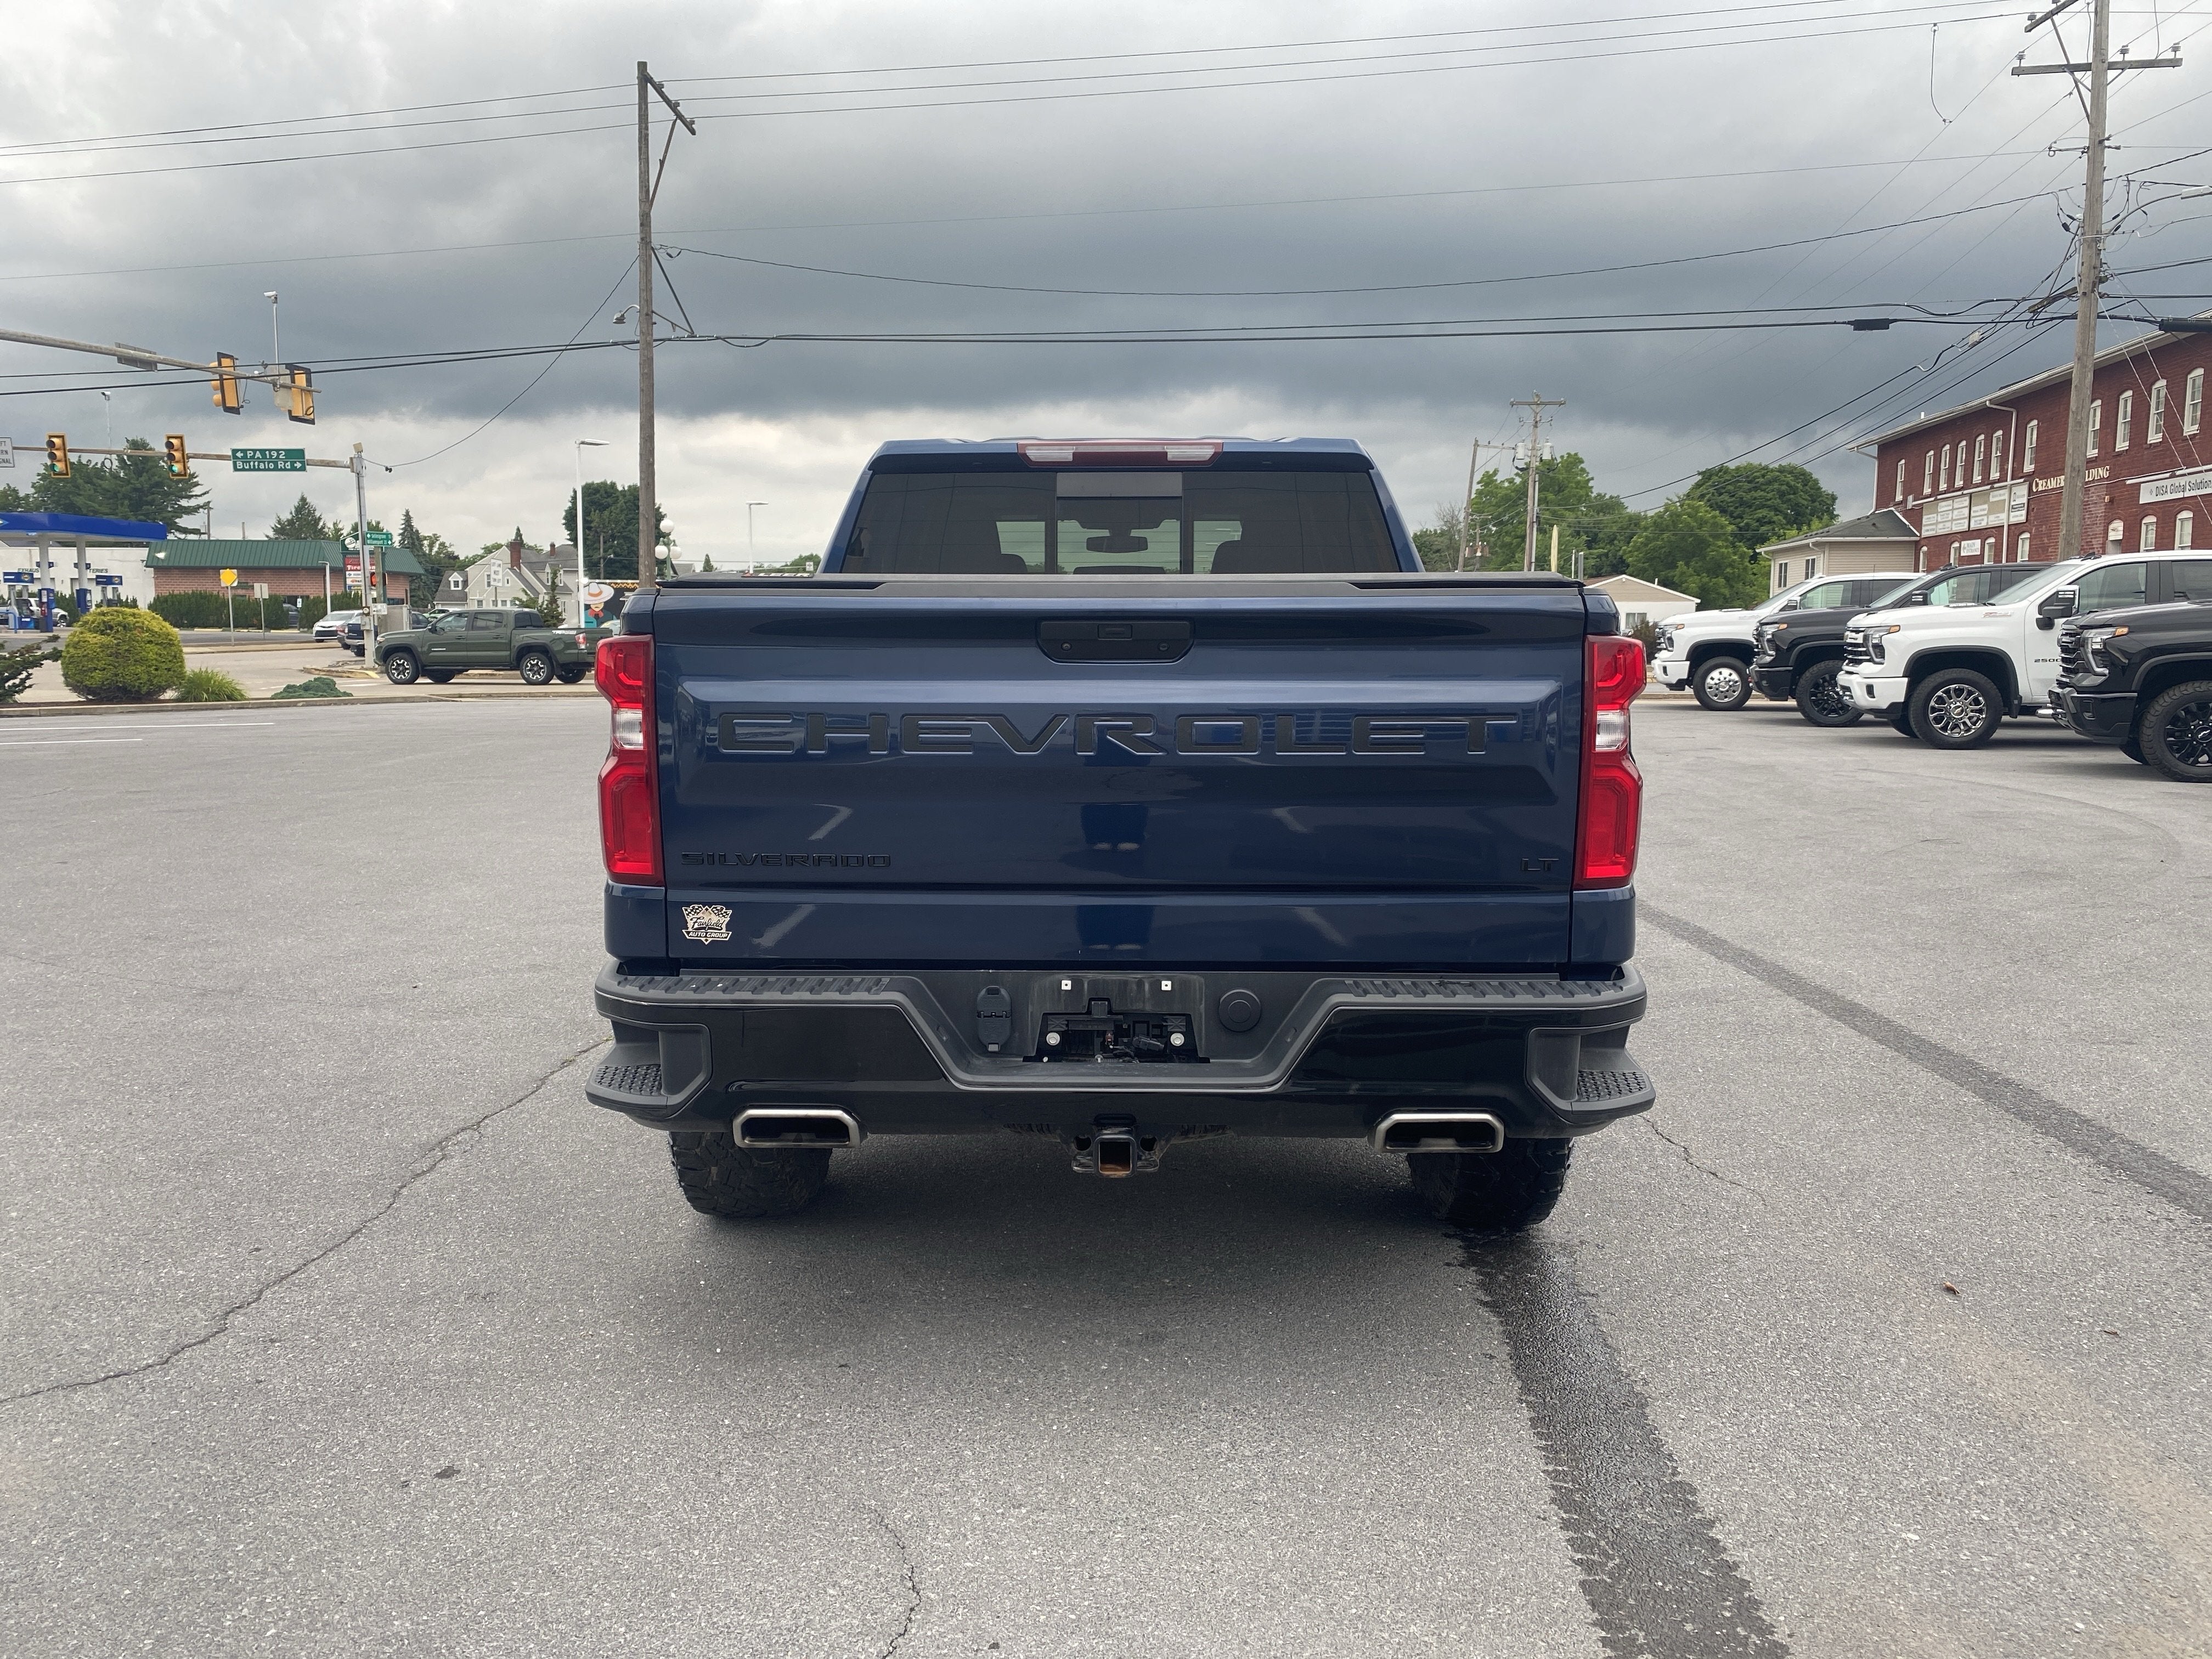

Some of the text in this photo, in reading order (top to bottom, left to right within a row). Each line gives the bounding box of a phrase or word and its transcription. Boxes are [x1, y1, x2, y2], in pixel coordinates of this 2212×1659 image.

[246, 450, 286, 459] PA 192
[236, 461, 291, 469] Buffalo Rd
[2085, 465, 2110, 482] LDING
[2155, 485, 2168, 496] DISA
[2170, 481, 2187, 494] Global
[717, 713, 1518, 755] CHEVROLET
[681, 851, 891, 867] SILVERADO
[1521, 858, 1559, 871] LT
[690, 916, 726, 931] Fairfield
